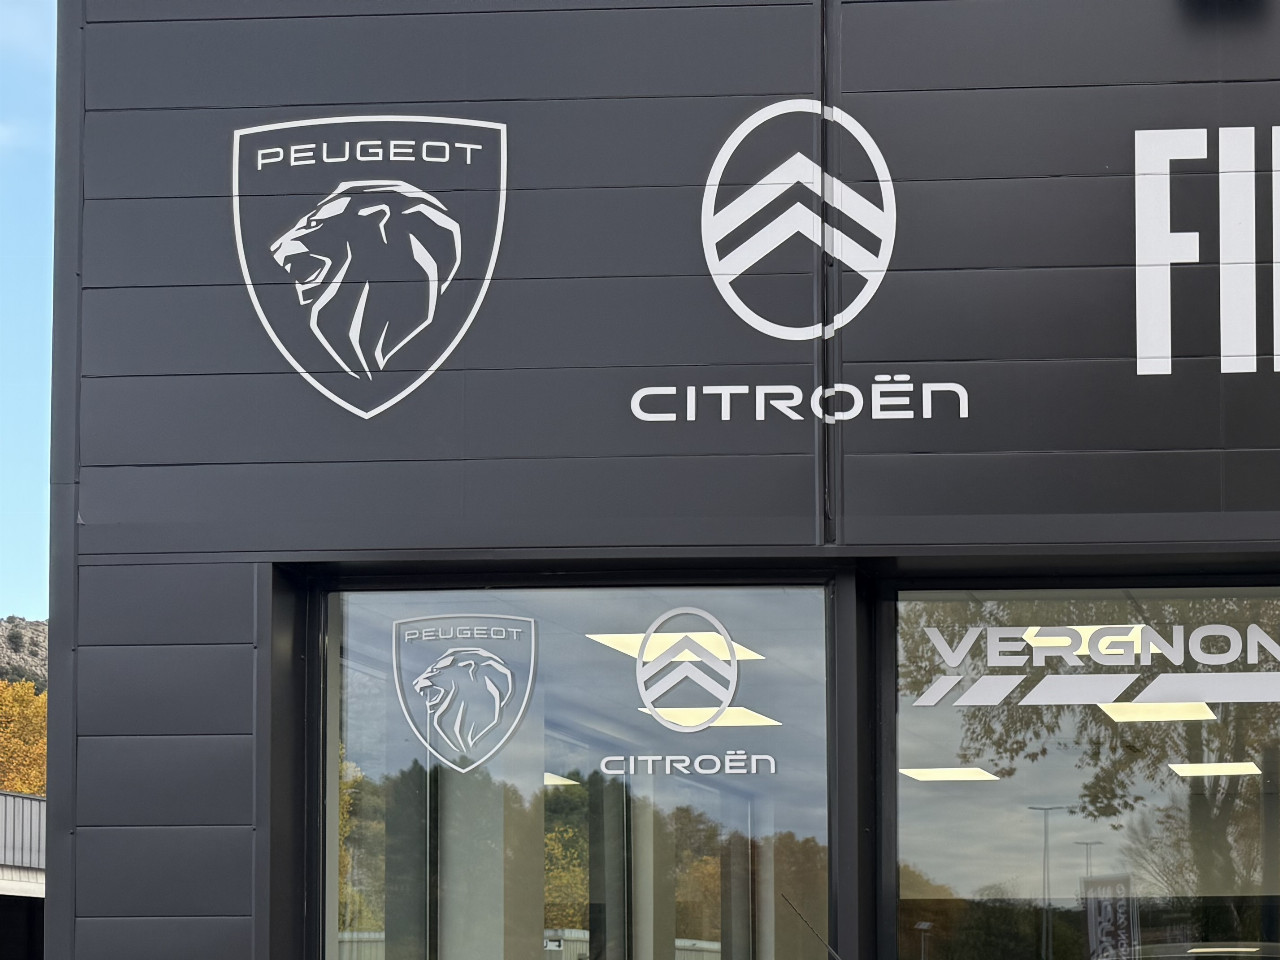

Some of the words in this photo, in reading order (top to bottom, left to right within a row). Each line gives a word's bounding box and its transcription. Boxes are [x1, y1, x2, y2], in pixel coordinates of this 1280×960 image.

[257, 141, 482, 171] PEUGEOT
[631, 374, 969, 424] CITROËN
[404, 627, 522, 643] PEUGEOT
[600, 750, 776, 775] CITROËN
